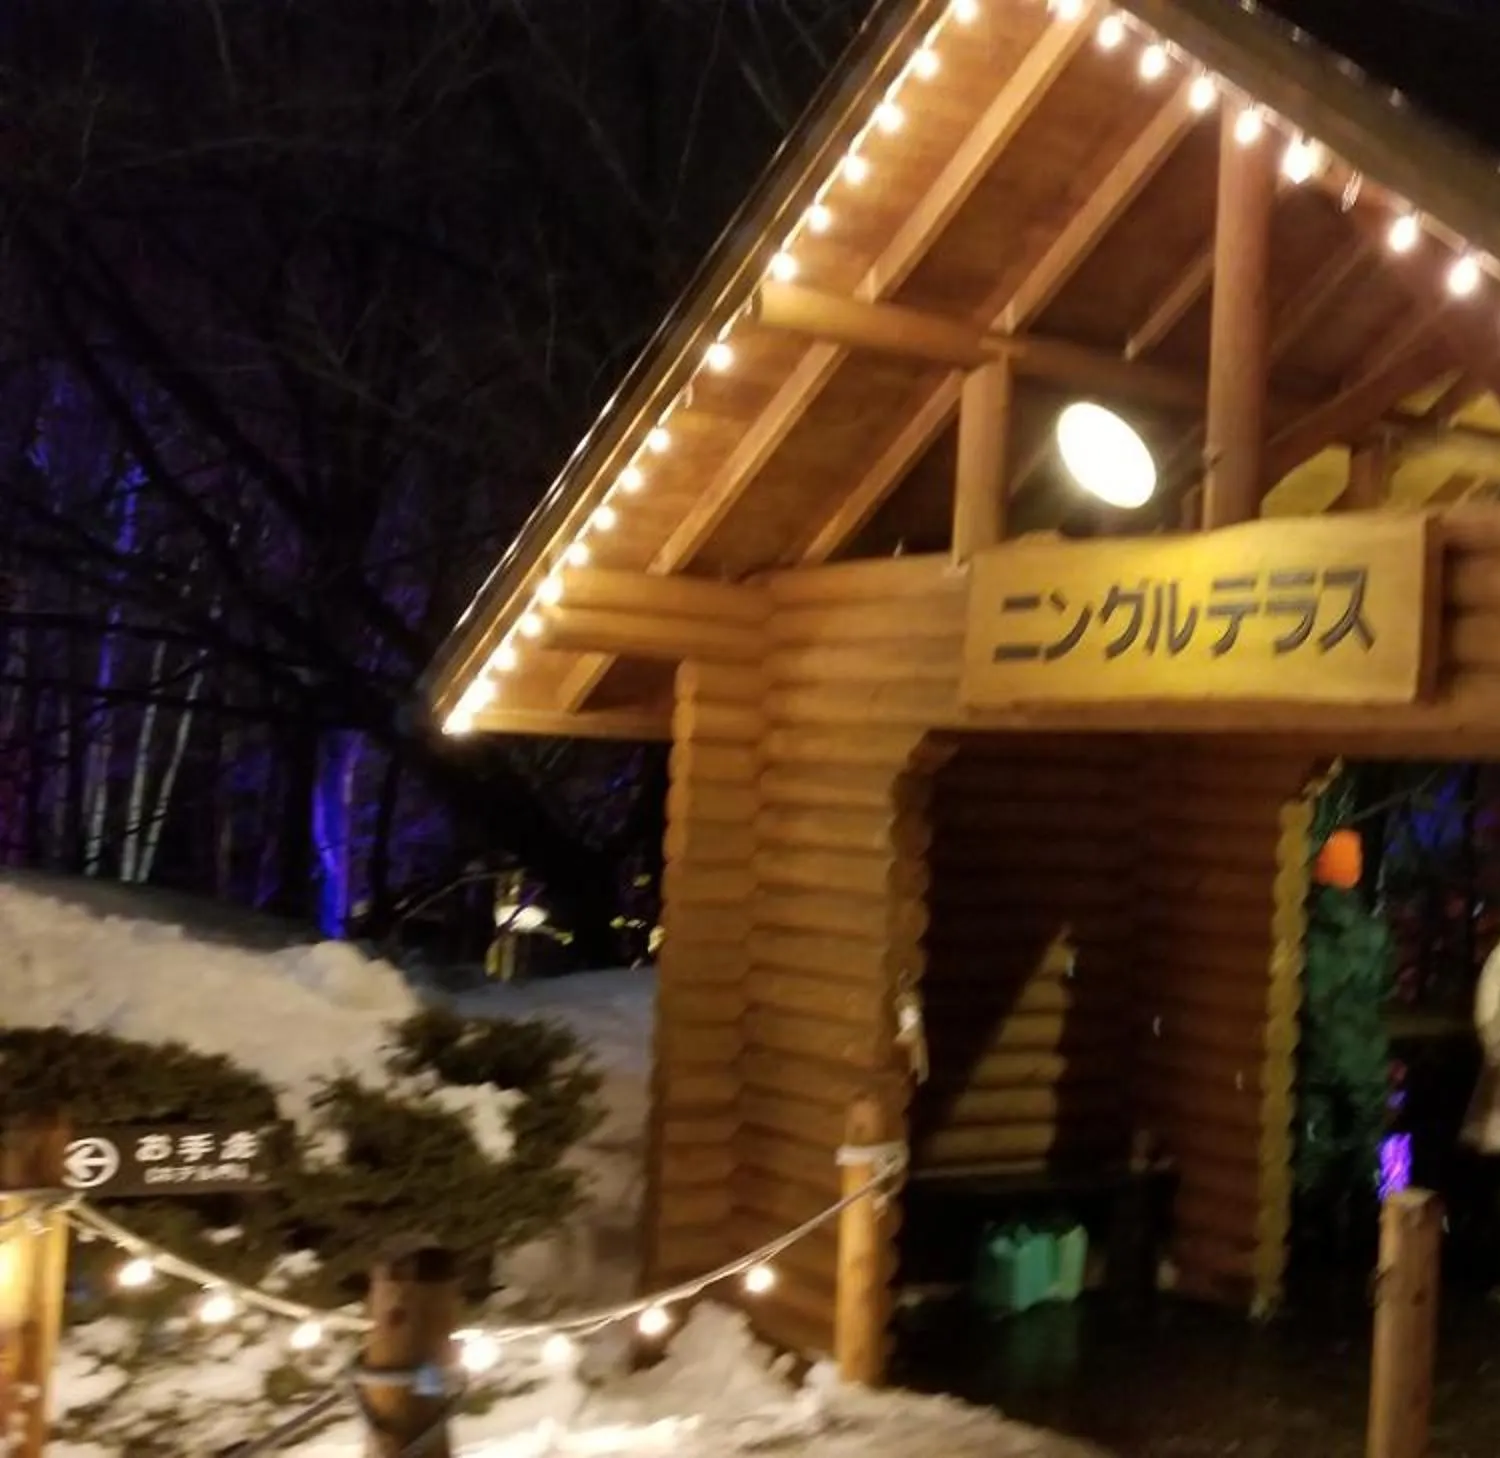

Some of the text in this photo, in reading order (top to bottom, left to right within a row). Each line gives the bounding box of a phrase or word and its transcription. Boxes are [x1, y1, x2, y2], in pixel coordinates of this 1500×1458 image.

[993, 565, 1377, 664] ニングルテラス
